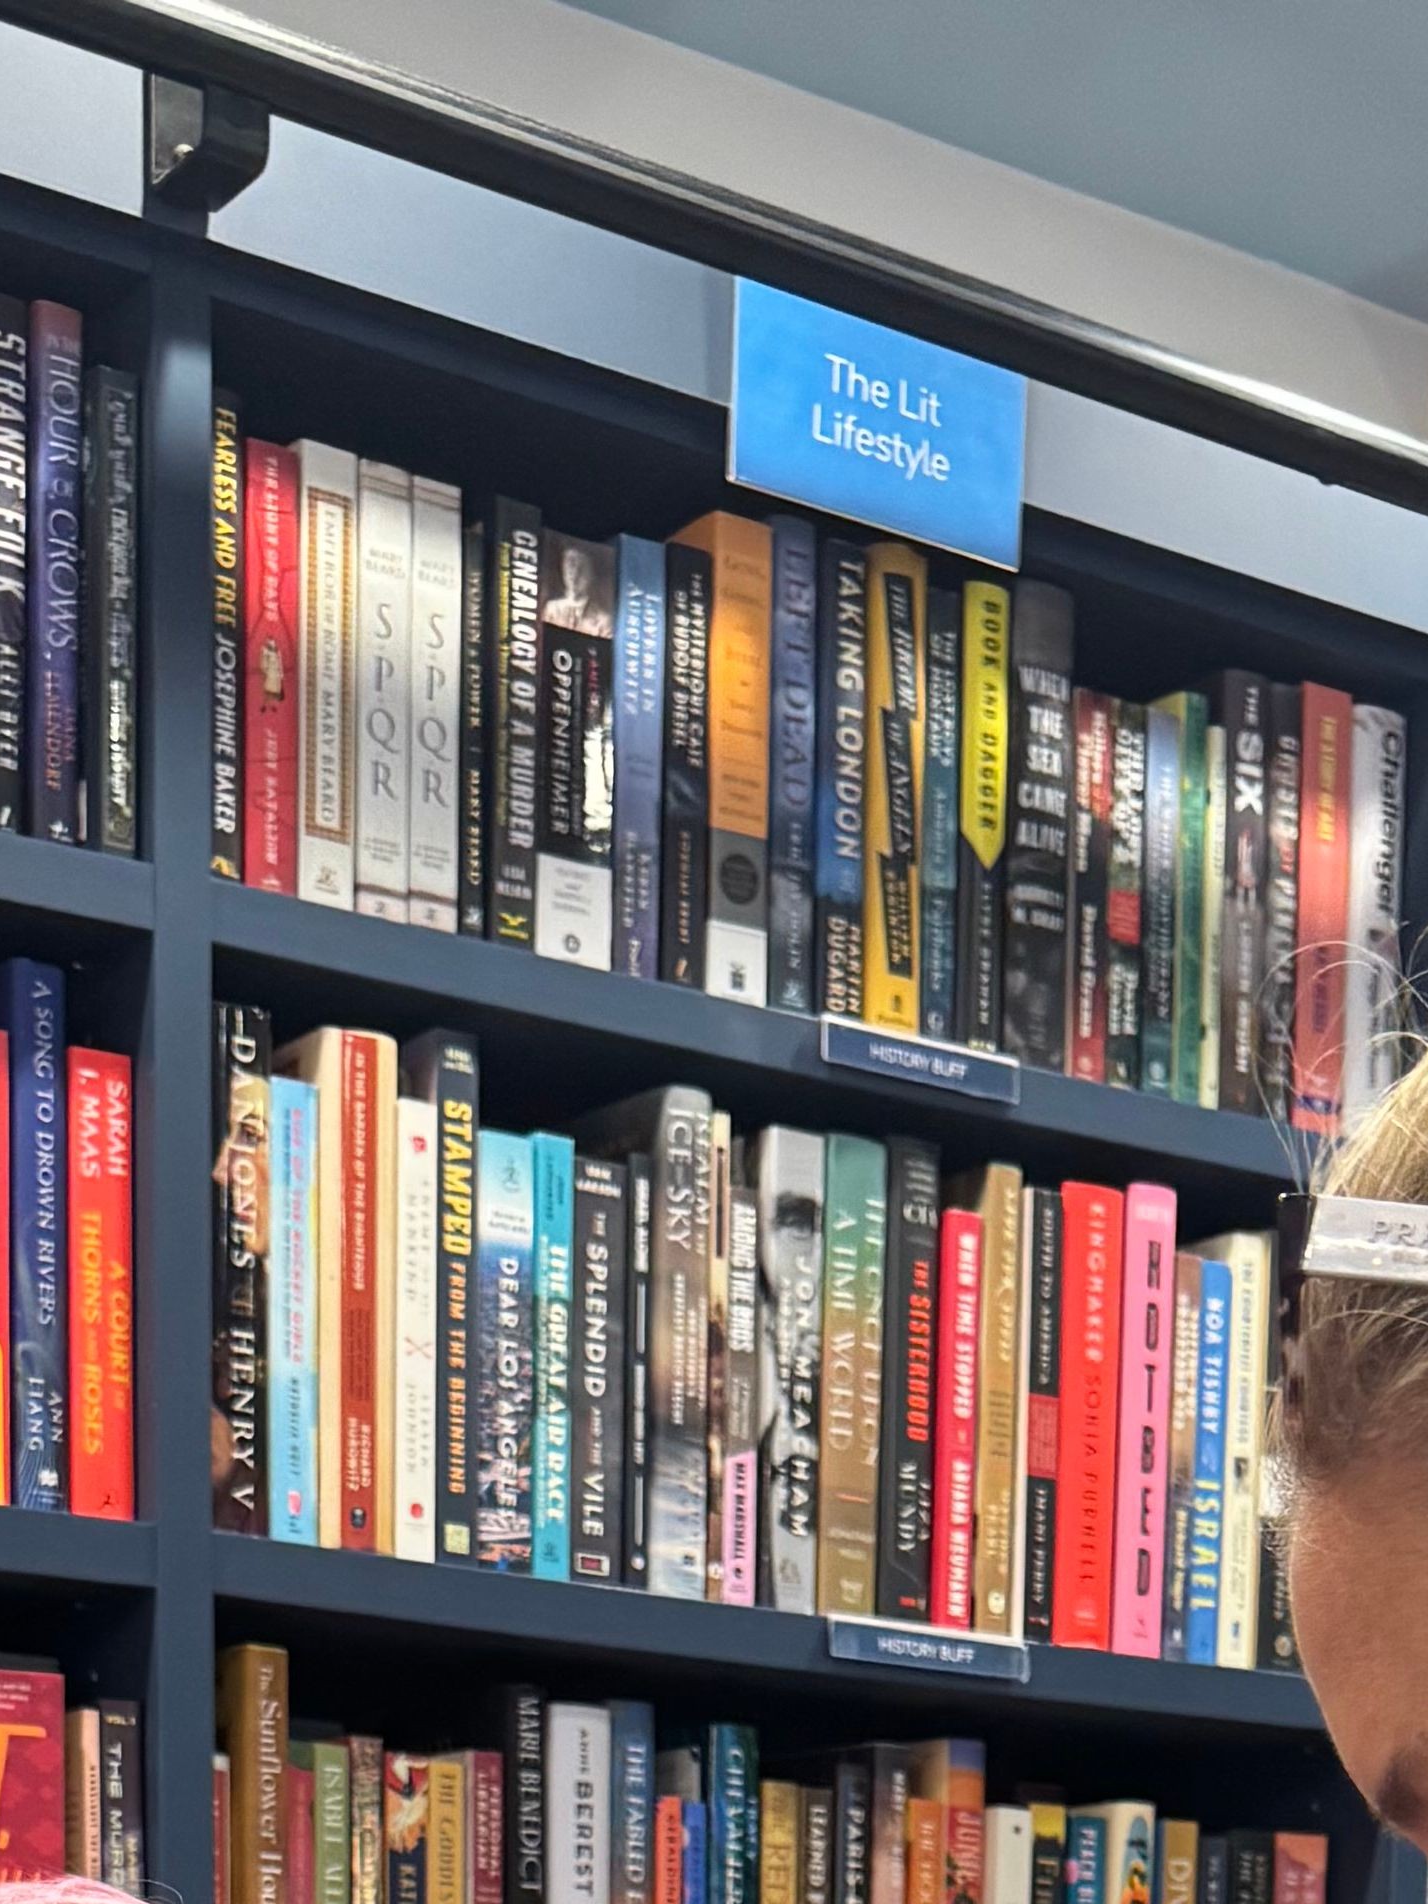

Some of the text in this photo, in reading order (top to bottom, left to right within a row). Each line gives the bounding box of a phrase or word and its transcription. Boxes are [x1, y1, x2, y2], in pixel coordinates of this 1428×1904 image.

[809, 403, 952, 483] Lifestyle
[823, 352, 944, 429] The Lit
[213, 632, 237, 836] JOSEPHINE BAKER
[508, 529, 539, 849] GENEALOGY MURDER
[834, 560, 867, 861] TAKING LONDON
[1231, 733, 1264, 816] SIX
[931, 1056, 968, 1080] BUFF
[442, 1099, 474, 1497] STAMPED BEGINNING
[1189, 1478, 1221, 1613] ISRAEL
[878, 1637, 975, 1664] HISTORY BUFF
[572, 1783, 594, 1898] BEREST
